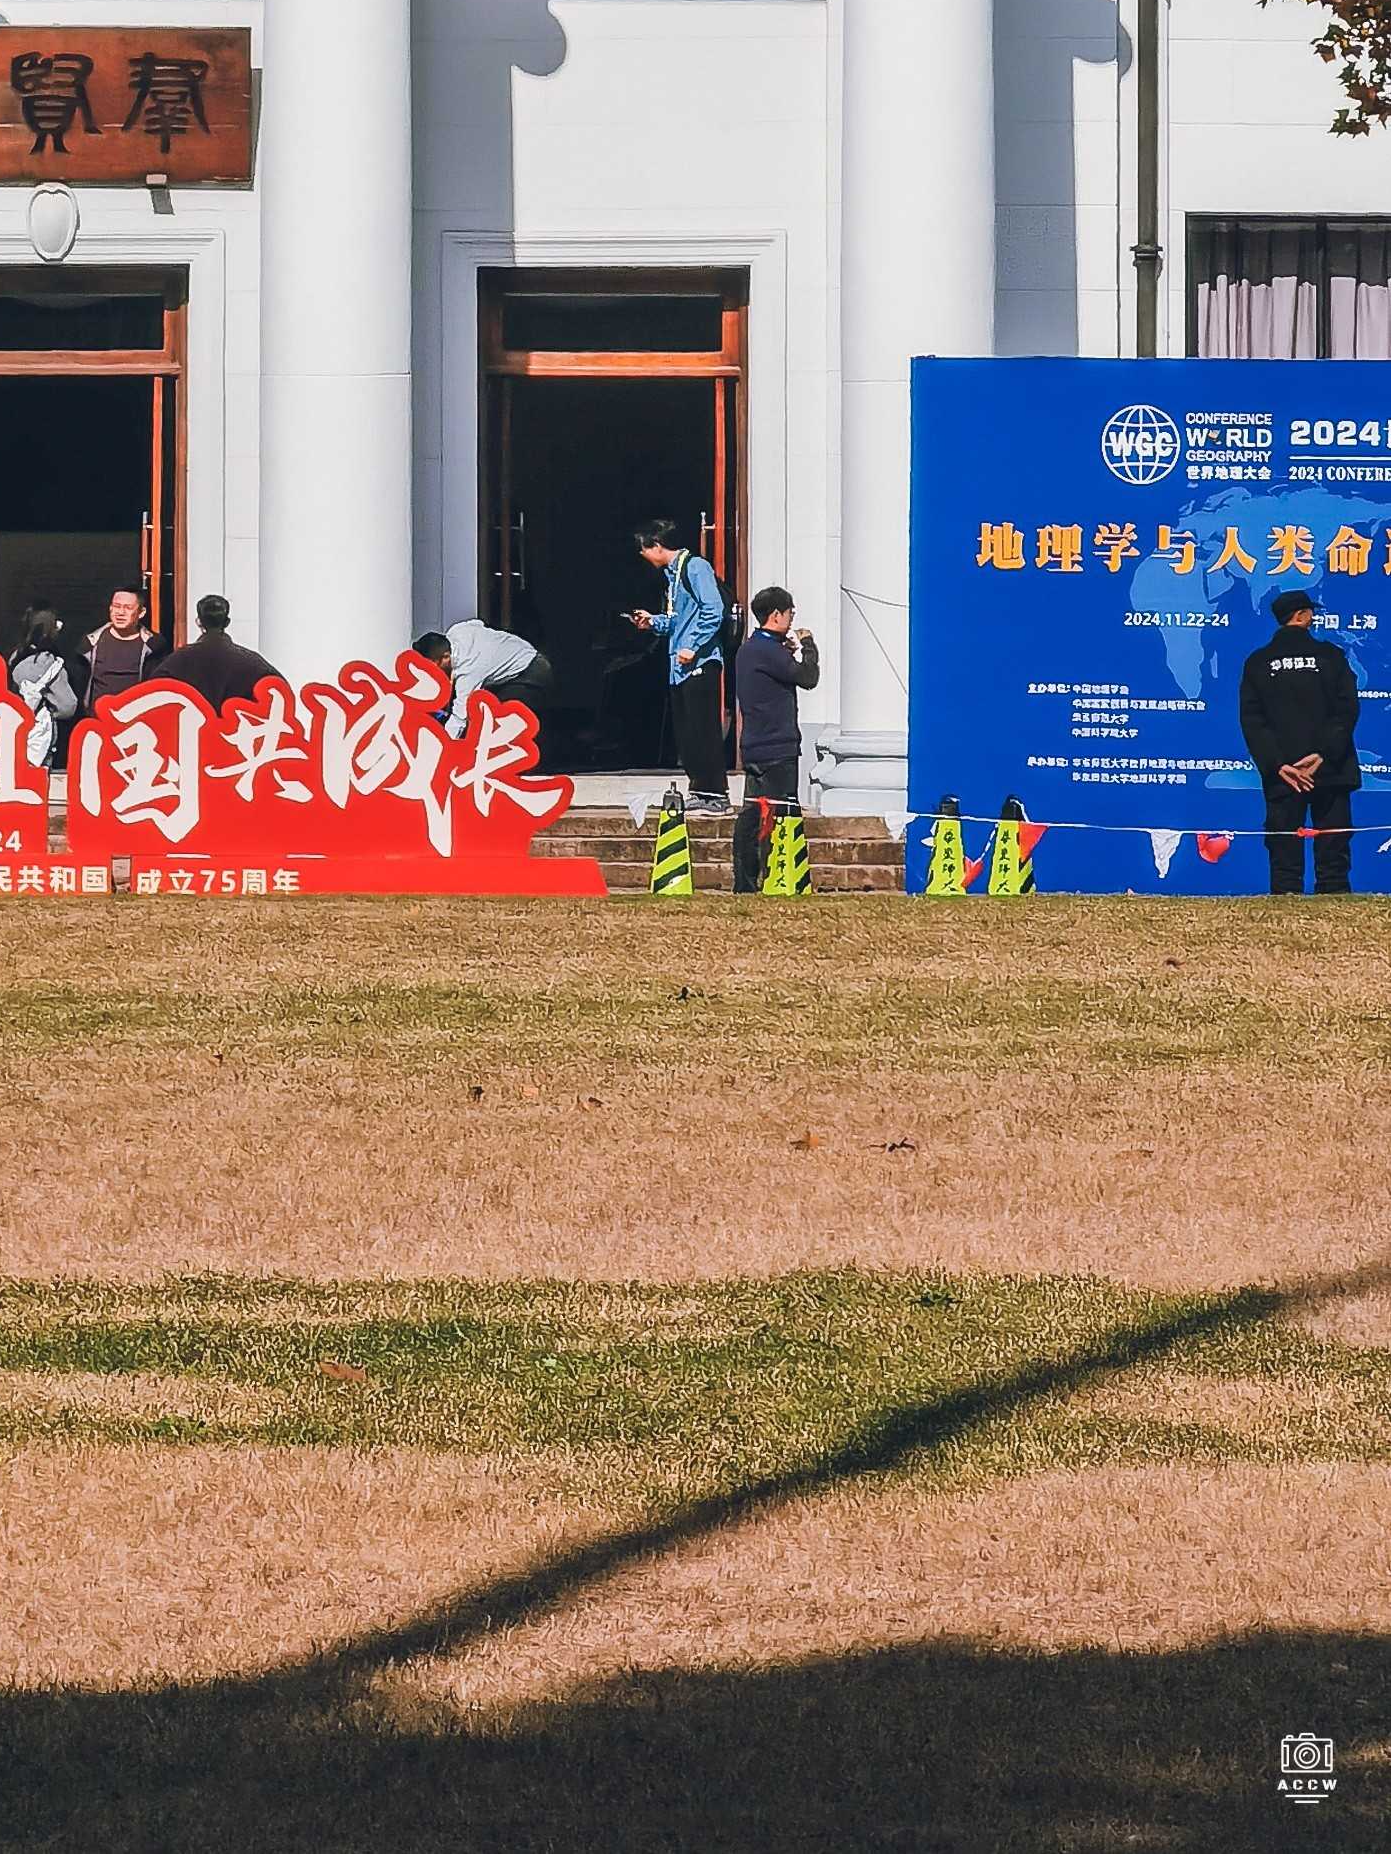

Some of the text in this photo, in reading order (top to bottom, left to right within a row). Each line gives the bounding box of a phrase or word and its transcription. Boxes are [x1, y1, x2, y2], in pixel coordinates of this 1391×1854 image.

[1186, 412, 1272, 425] CONFERENCE
[1109, 430, 1174, 457] WGC
[1186, 428, 1272, 447] WRLD
[1186, 449, 1271, 462] GEOGRAPHY
[1186, 465, 1271, 480] 世界地理大会
[1289, 466, 1323, 481] 2024
[1123, 612, 1229, 627] 2024.11.22-24
[1348, 615, 1377, 630] 上海
[136, 868, 301, 895] 成立75周年
